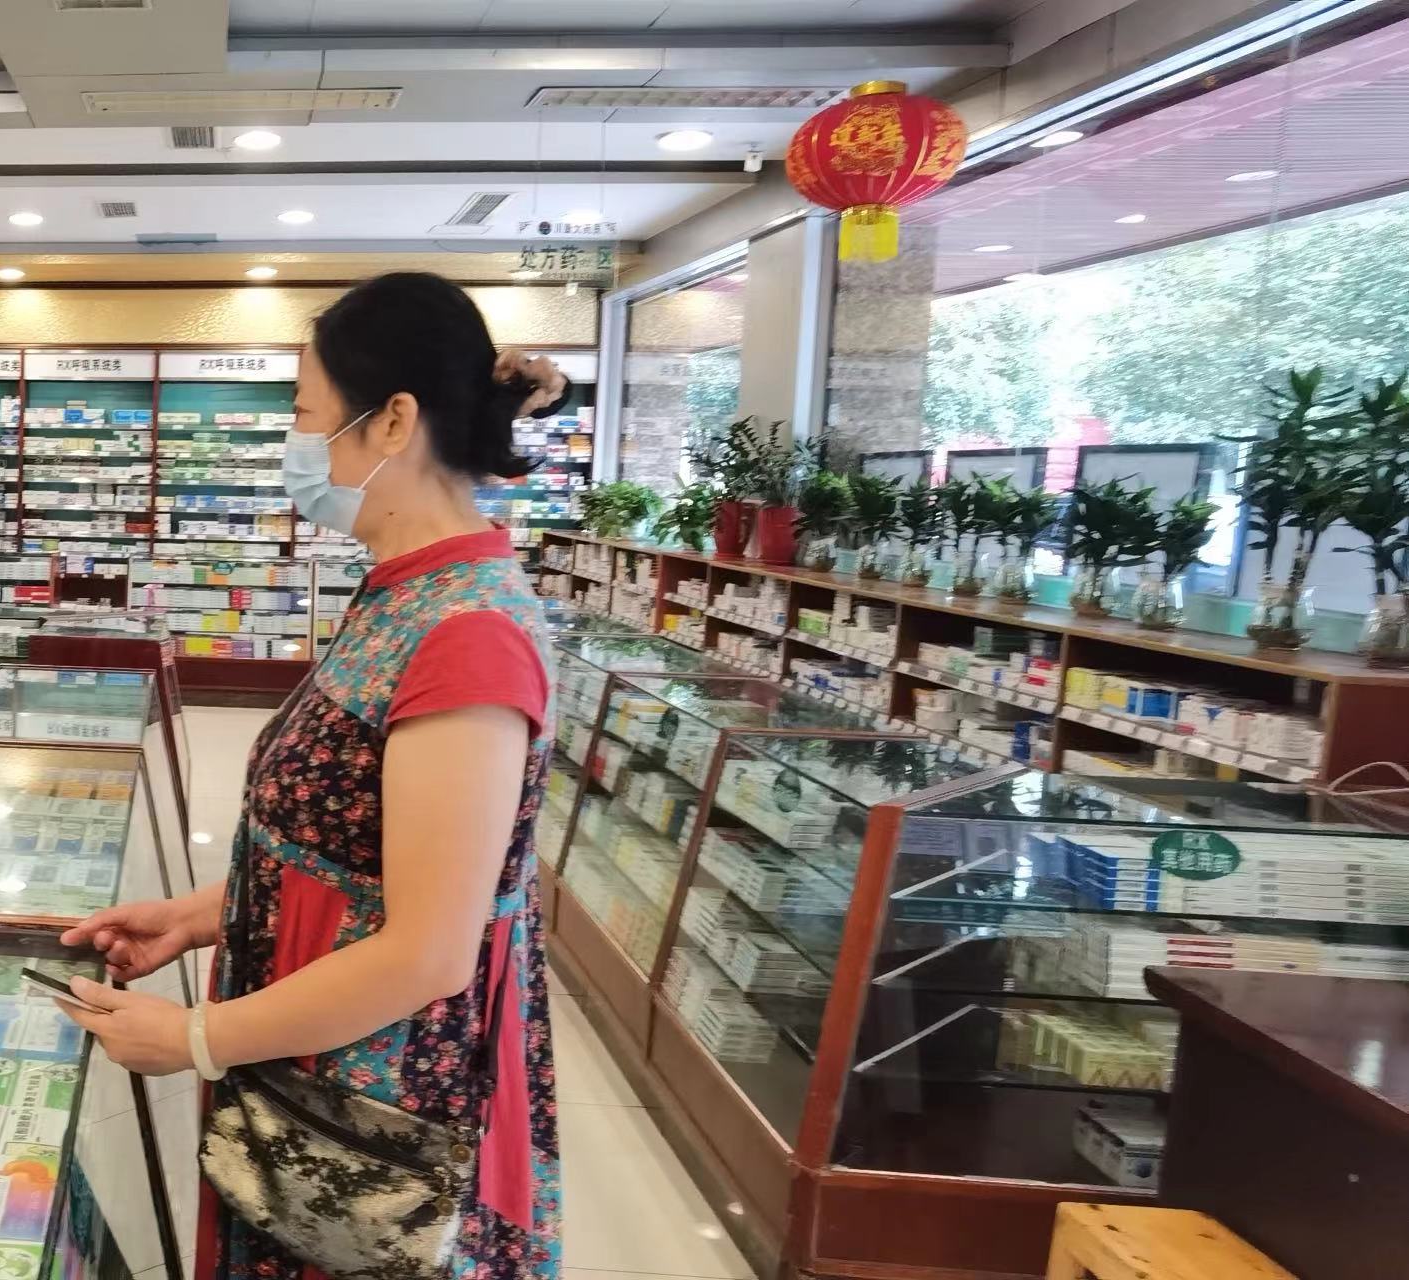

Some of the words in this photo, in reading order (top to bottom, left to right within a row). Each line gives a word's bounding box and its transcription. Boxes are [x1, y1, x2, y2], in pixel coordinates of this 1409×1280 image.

[56, 359, 122, 372] RX呼吸系统类
[199, 358, 267, 371] RX呼吸系统类
